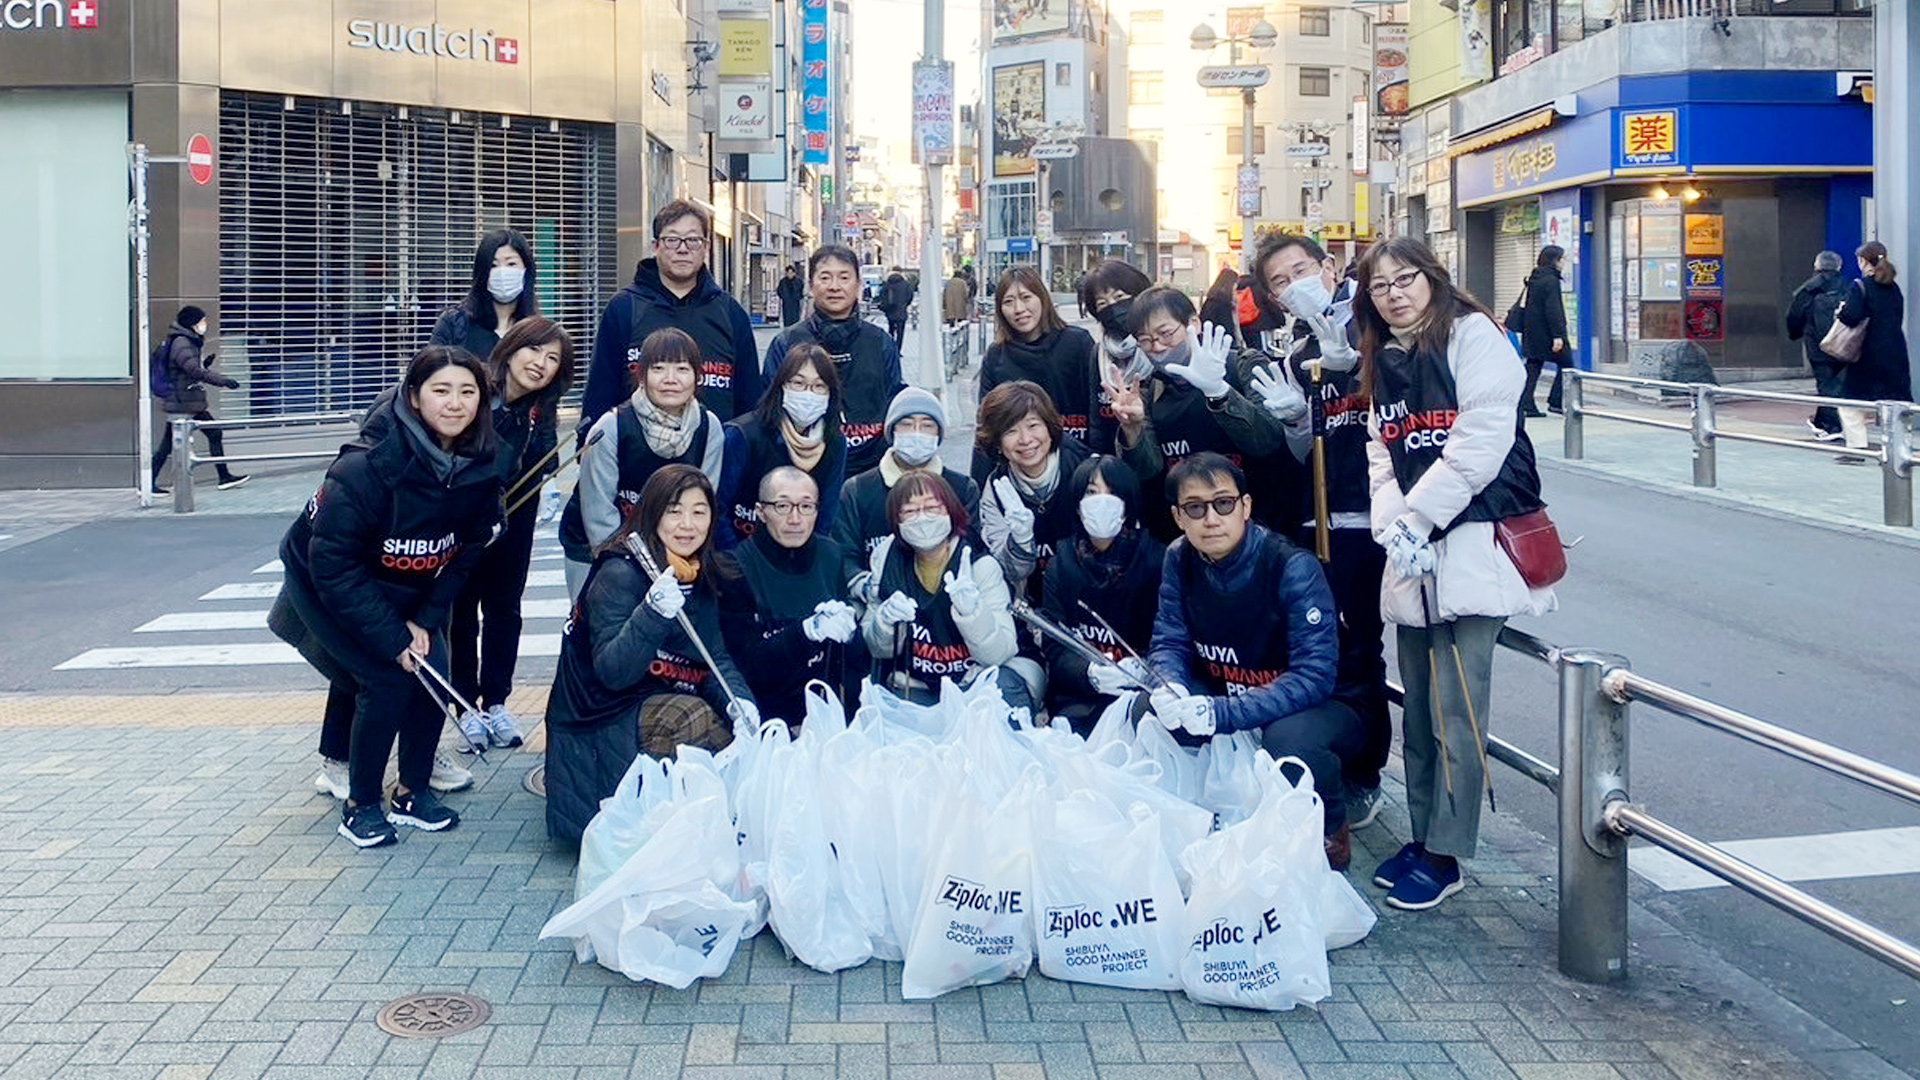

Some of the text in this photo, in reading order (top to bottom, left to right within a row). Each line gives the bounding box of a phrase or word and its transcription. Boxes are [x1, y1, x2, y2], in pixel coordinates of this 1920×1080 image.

[348, 19, 496, 62] swatch
[1631, 115, 1667, 152] 薬
[913, 656, 977, 673] PROJEC
[943, 881, 993, 911] Ziploc
[1049, 909, 1104, 938] Ziploc
[1065, 944, 1110, 956] SHIBUYA
[1066, 949, 1147, 967] GOOD MANNER
[1102, 959, 1148, 973] PROJECT
[1203, 960, 1248, 972] SHIBUYA
[1203, 972, 1237, 983] GOOD
